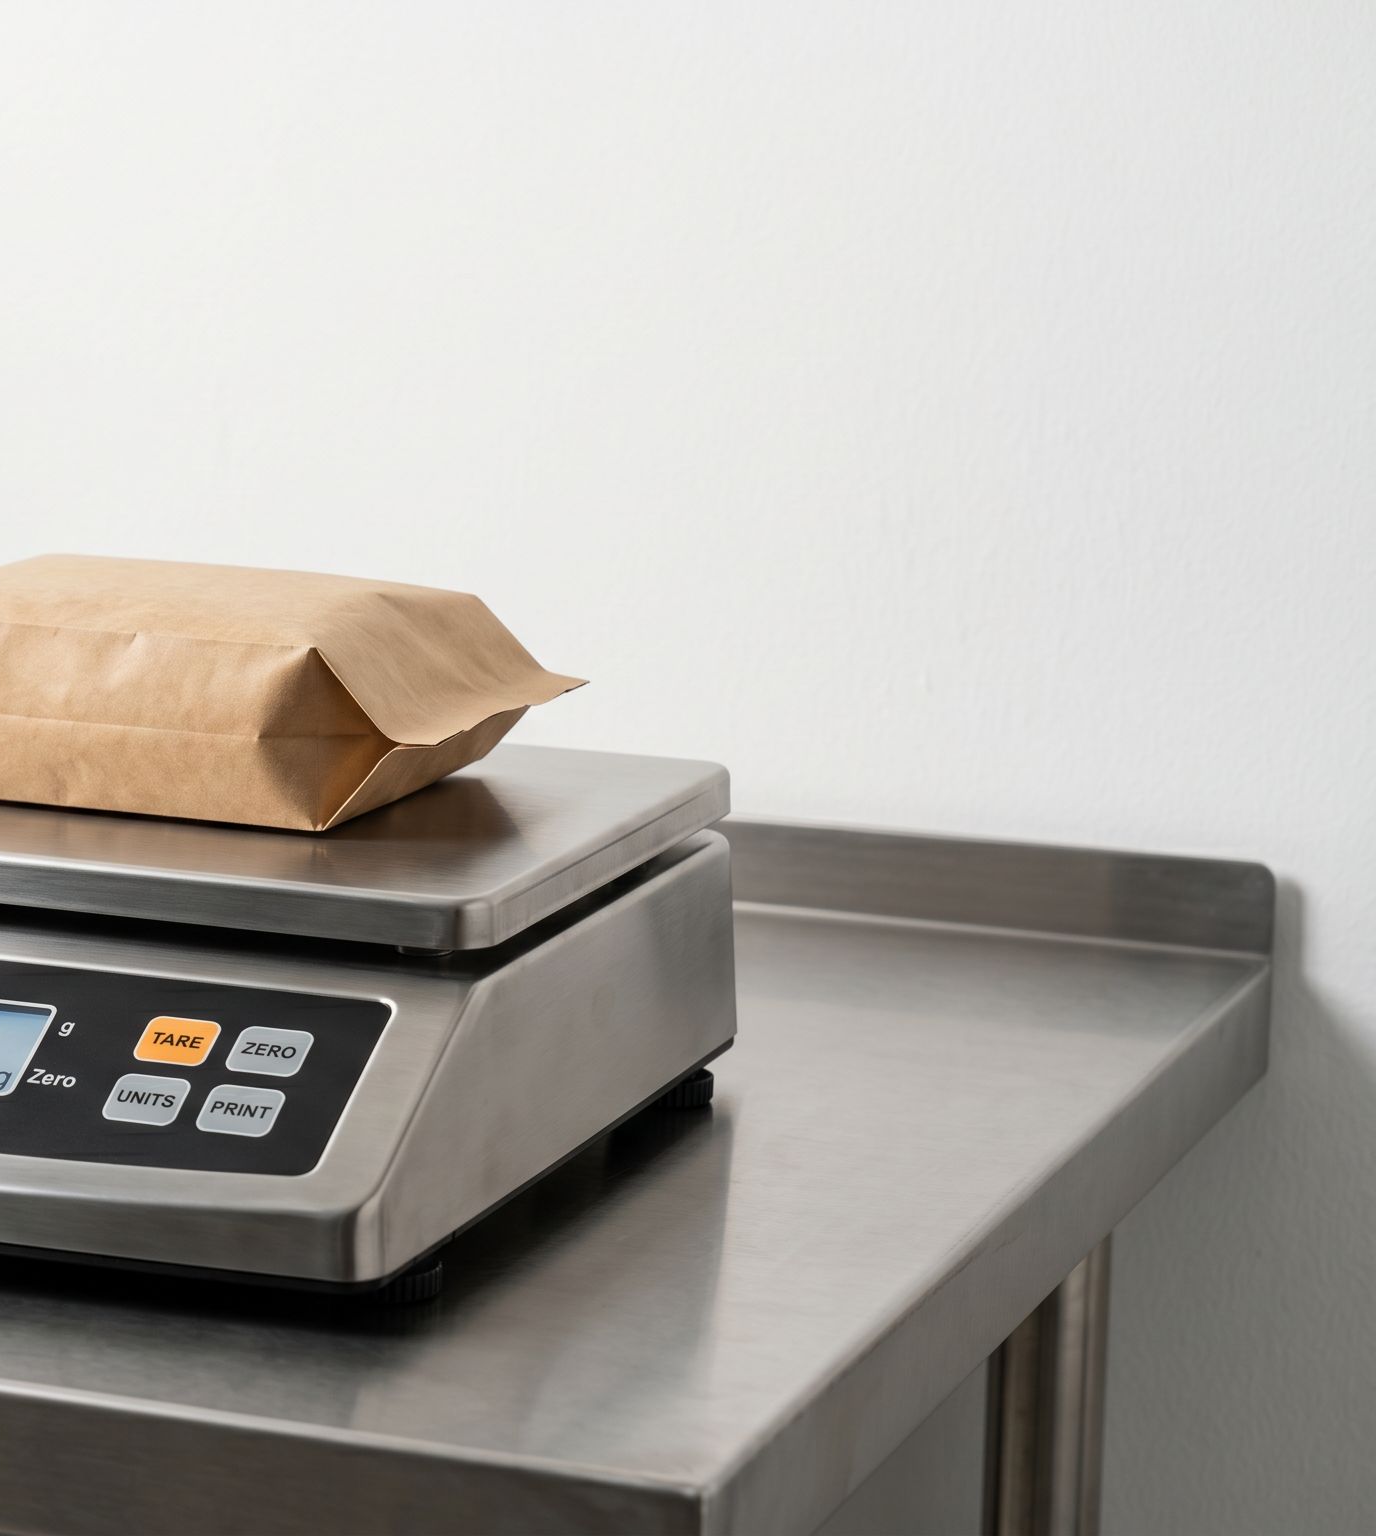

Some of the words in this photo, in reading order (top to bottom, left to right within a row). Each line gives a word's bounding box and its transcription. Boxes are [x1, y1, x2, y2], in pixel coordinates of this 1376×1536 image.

[58, 1019, 76, 1037] g
[152, 1031, 205, 1050] TARE
[240, 1041, 297, 1060] ZERO
[26, 1068, 77, 1089] Zero
[116, 1089, 177, 1109] UNITS
[209, 1100, 273, 1120] PRINT
